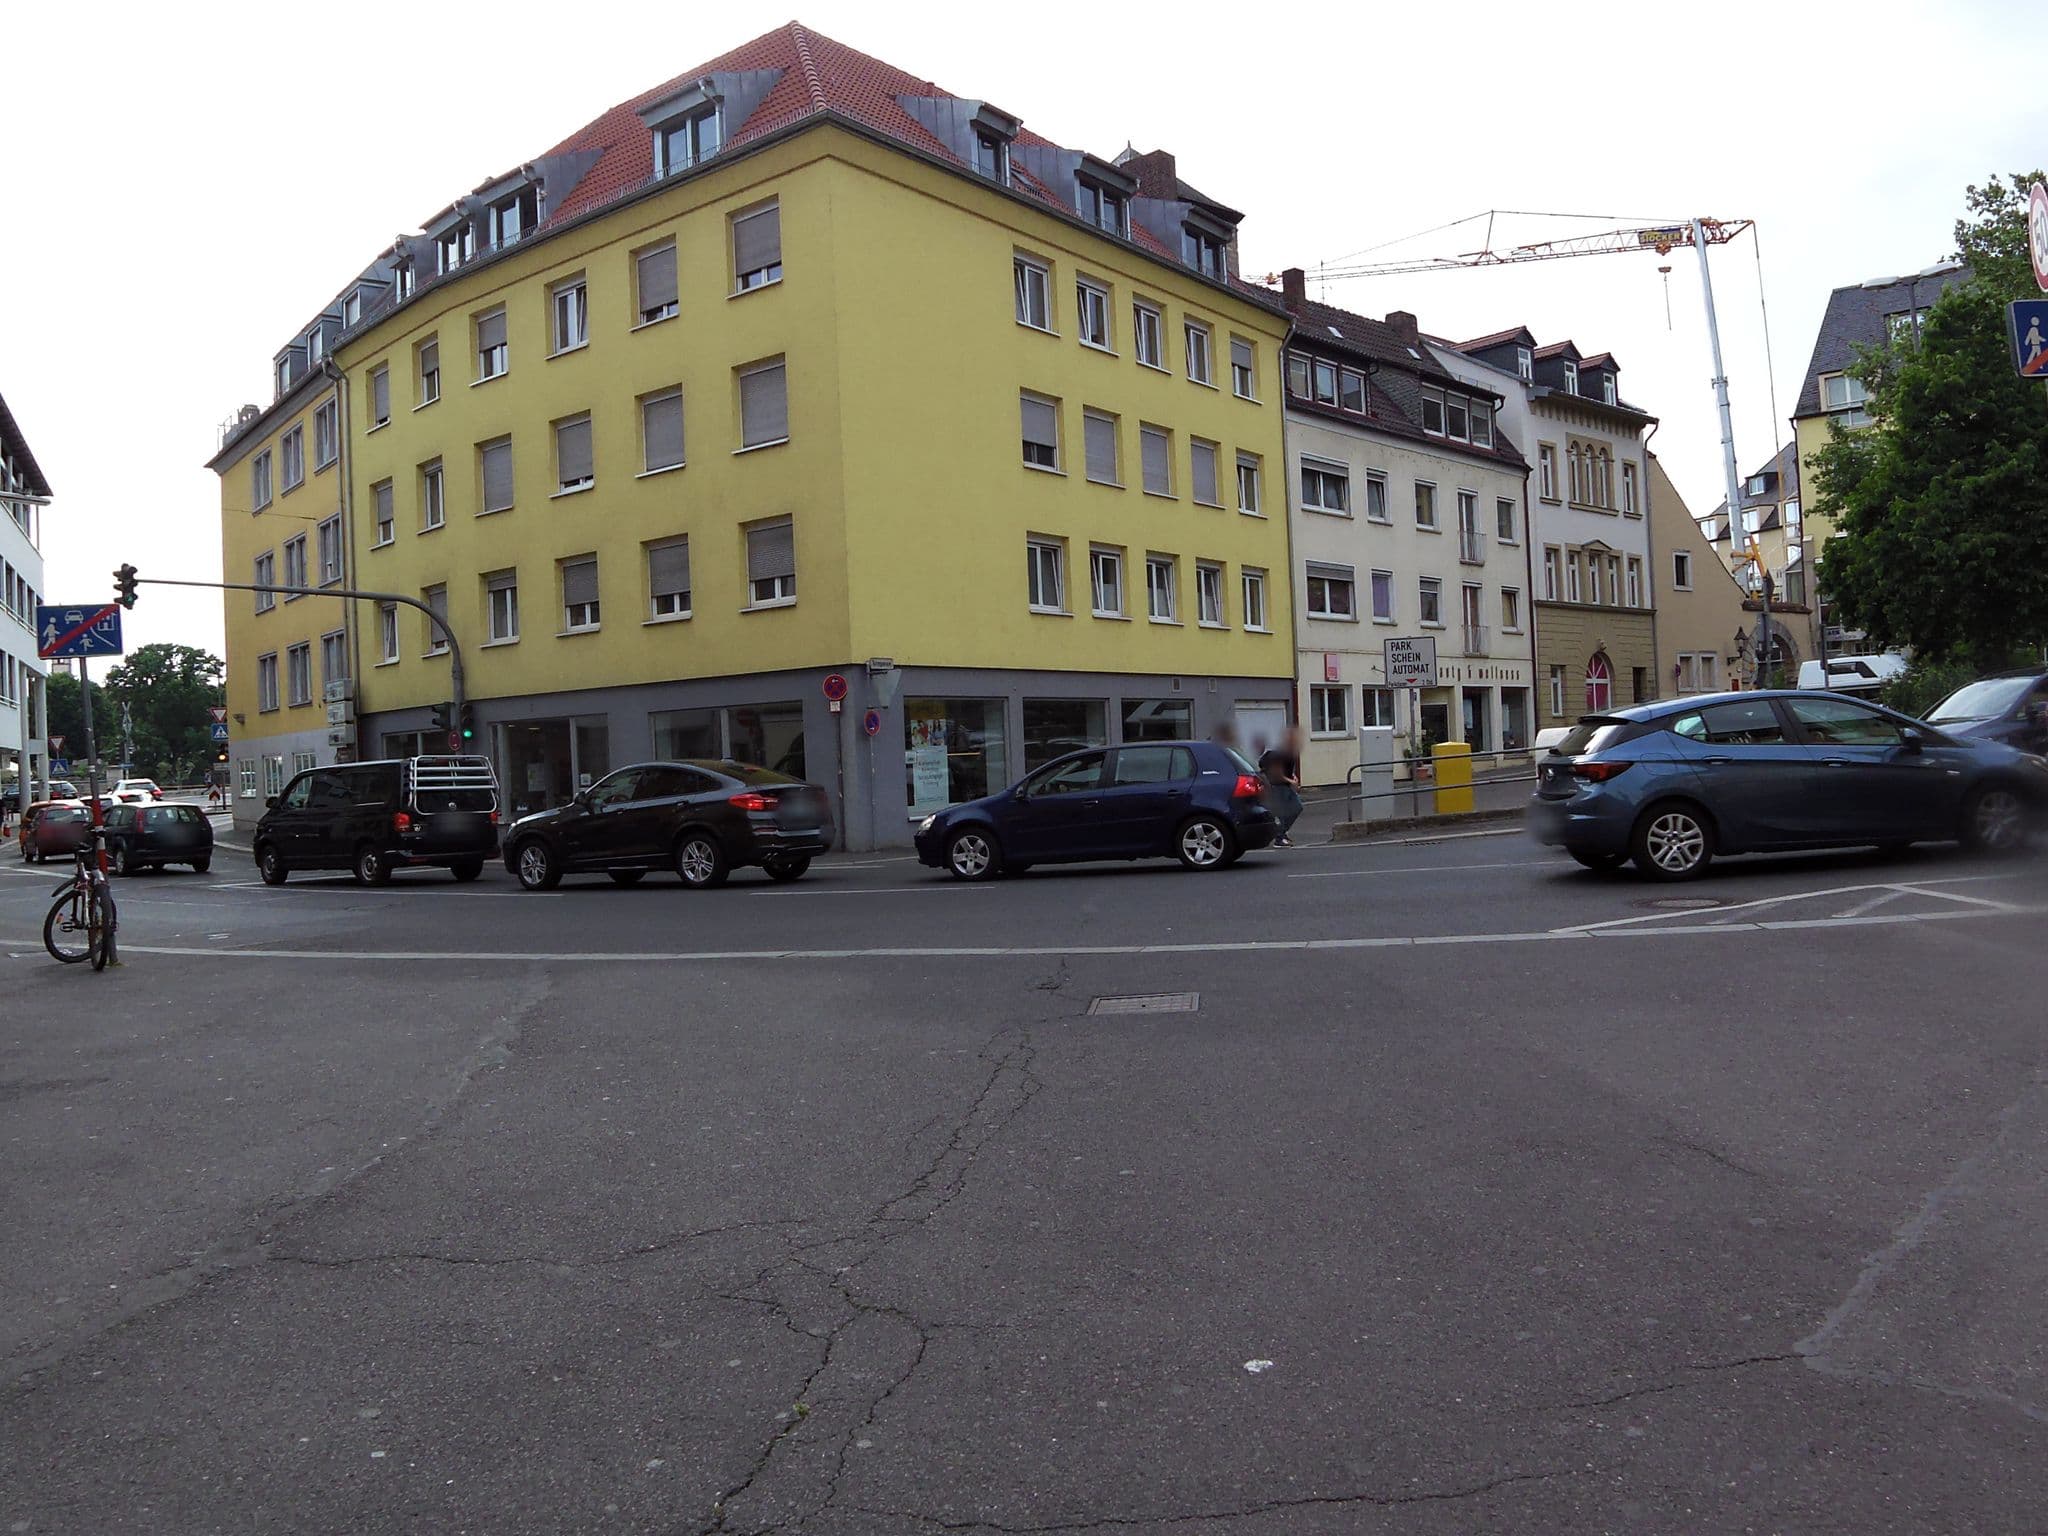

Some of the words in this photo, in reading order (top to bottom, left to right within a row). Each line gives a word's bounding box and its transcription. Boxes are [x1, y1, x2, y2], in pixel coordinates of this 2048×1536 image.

[1391, 641, 1412, 651] PARK
[1392, 653, 1421, 663] SCHEIN
[1392, 664, 1430, 674] AUTOMAT
